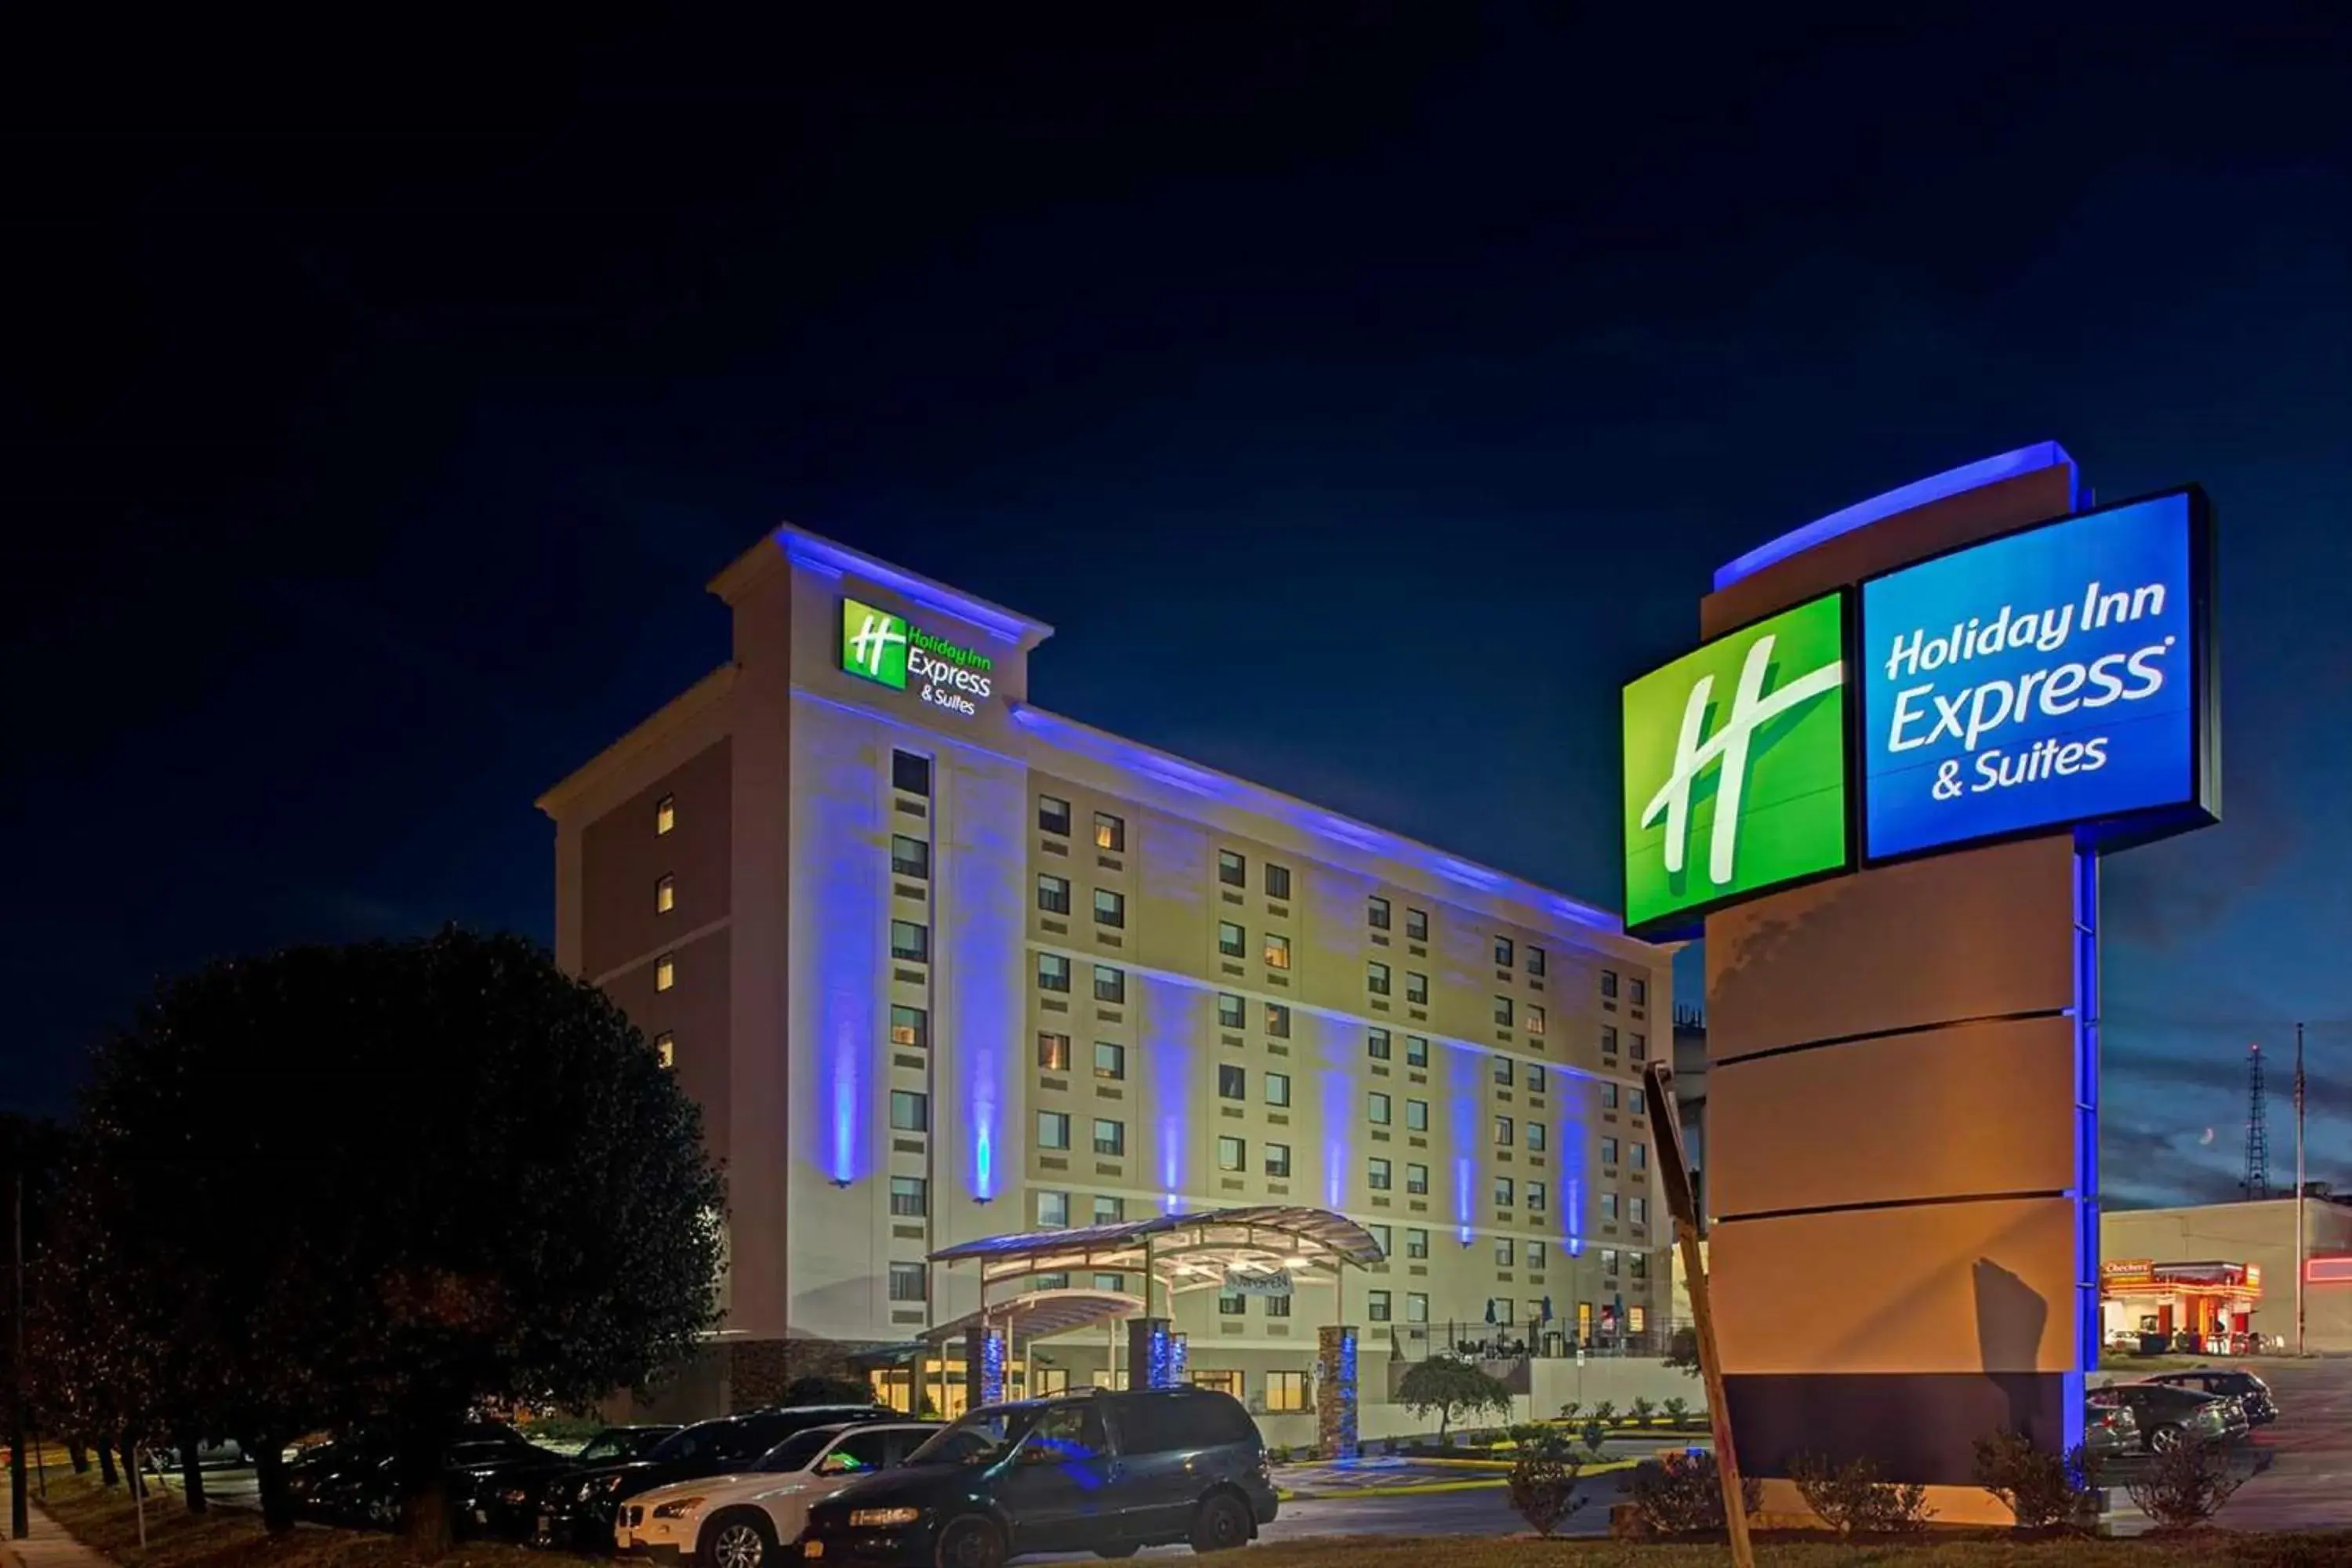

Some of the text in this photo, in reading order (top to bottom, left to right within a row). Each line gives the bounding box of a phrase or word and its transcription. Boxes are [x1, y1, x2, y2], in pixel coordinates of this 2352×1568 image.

[849, 615, 906, 675] H
[909, 626, 991, 670] Holiday Inn
[1886, 582, 2166, 681] Holiday Inn
[908, 646, 992, 697] Express
[921, 684, 975, 715] & Suites
[1888, 643, 2169, 753] Express
[1642, 633, 1842, 885] H
[1932, 737, 2109, 800] & Suites
